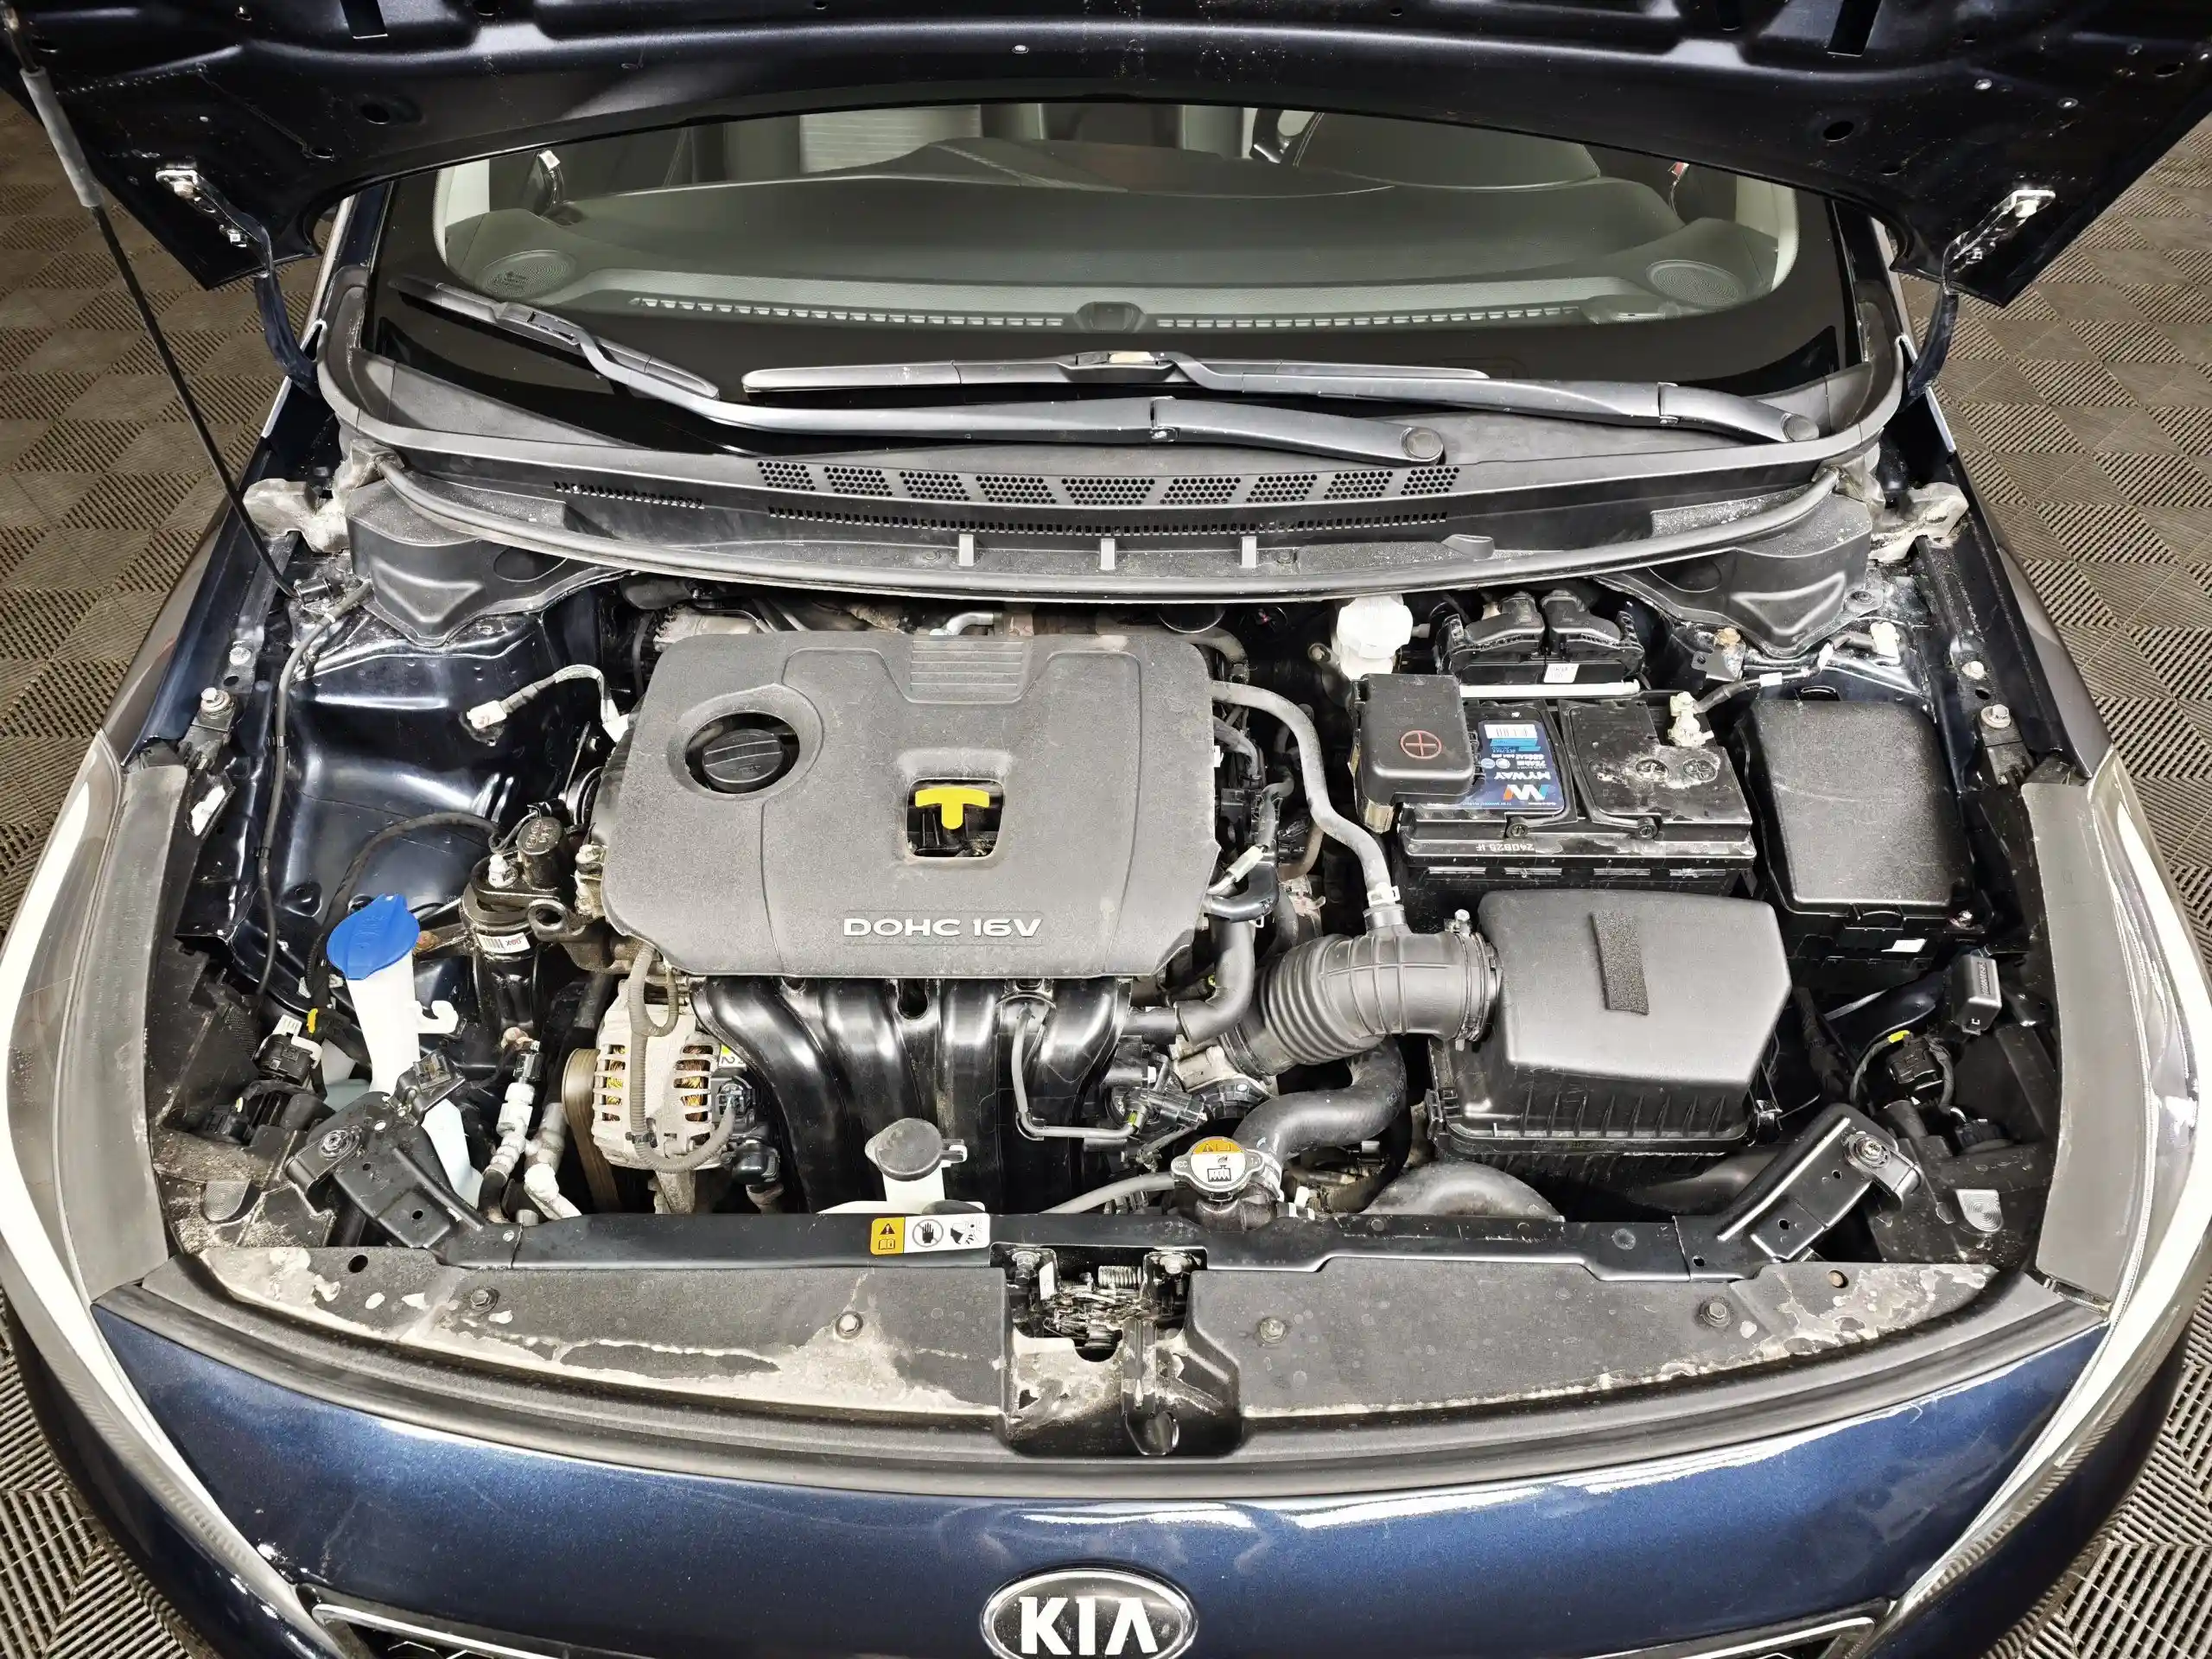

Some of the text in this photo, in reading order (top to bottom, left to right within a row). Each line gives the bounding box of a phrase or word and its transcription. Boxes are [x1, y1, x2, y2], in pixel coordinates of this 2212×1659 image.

[1494, 771, 1552, 780] MYWAY
[843, 918, 1042, 938] DOHC 16V
[1019, 1596, 1159, 1656] KIA
